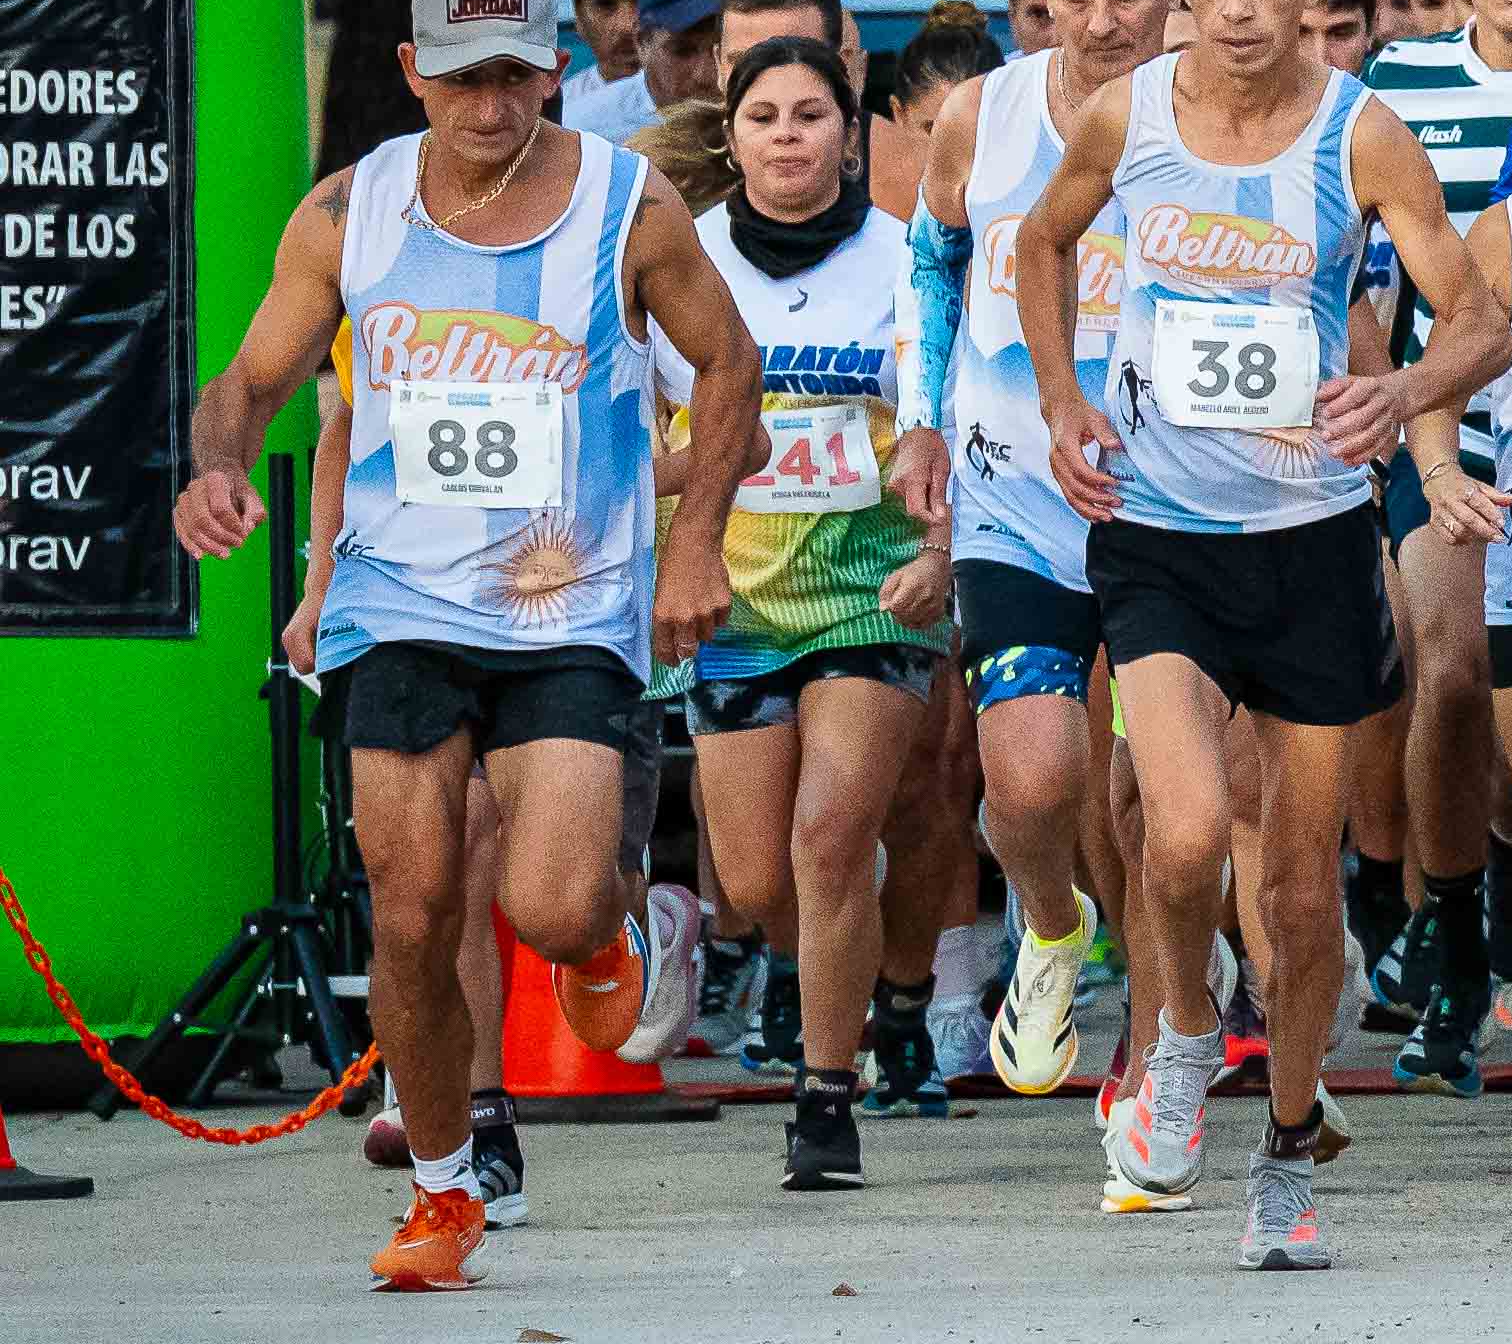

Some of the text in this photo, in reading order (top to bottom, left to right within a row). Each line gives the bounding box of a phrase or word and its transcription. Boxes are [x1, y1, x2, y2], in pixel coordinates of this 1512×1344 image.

[1417, 125, 1463, 144] flash
[105, 142, 169, 187] LAS
[4, 213, 136, 259] DE LOS
[1187, 339, 1277, 400] 38
[427, 419, 519, 479] 88
